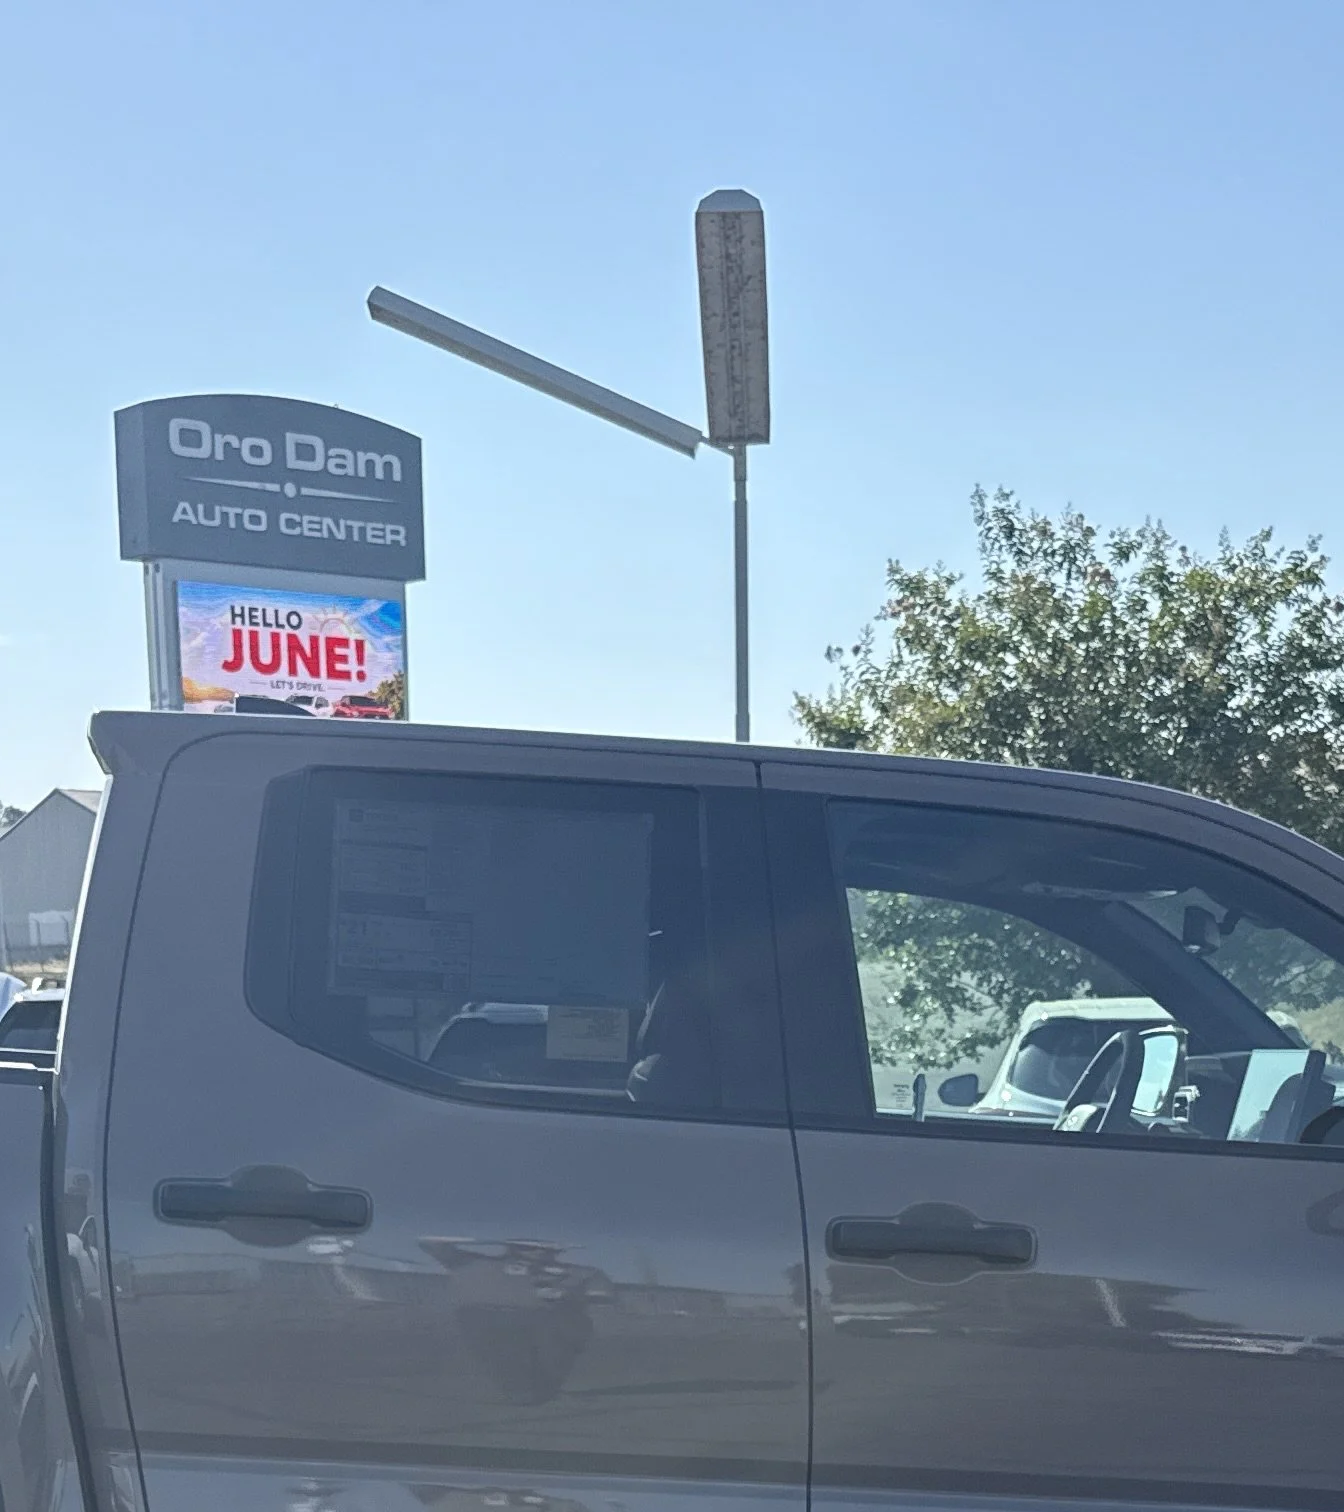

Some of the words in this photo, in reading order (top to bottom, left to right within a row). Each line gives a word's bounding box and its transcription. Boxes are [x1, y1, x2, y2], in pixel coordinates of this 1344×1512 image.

[168, 417, 273, 467] Oro
[285, 431, 402, 483] Dam
[172, 500, 268, 532] AUTO
[279, 511, 407, 547] CENTER
[230, 604, 303, 630] HELLO
[221, 627, 367, 683] JUNE!
